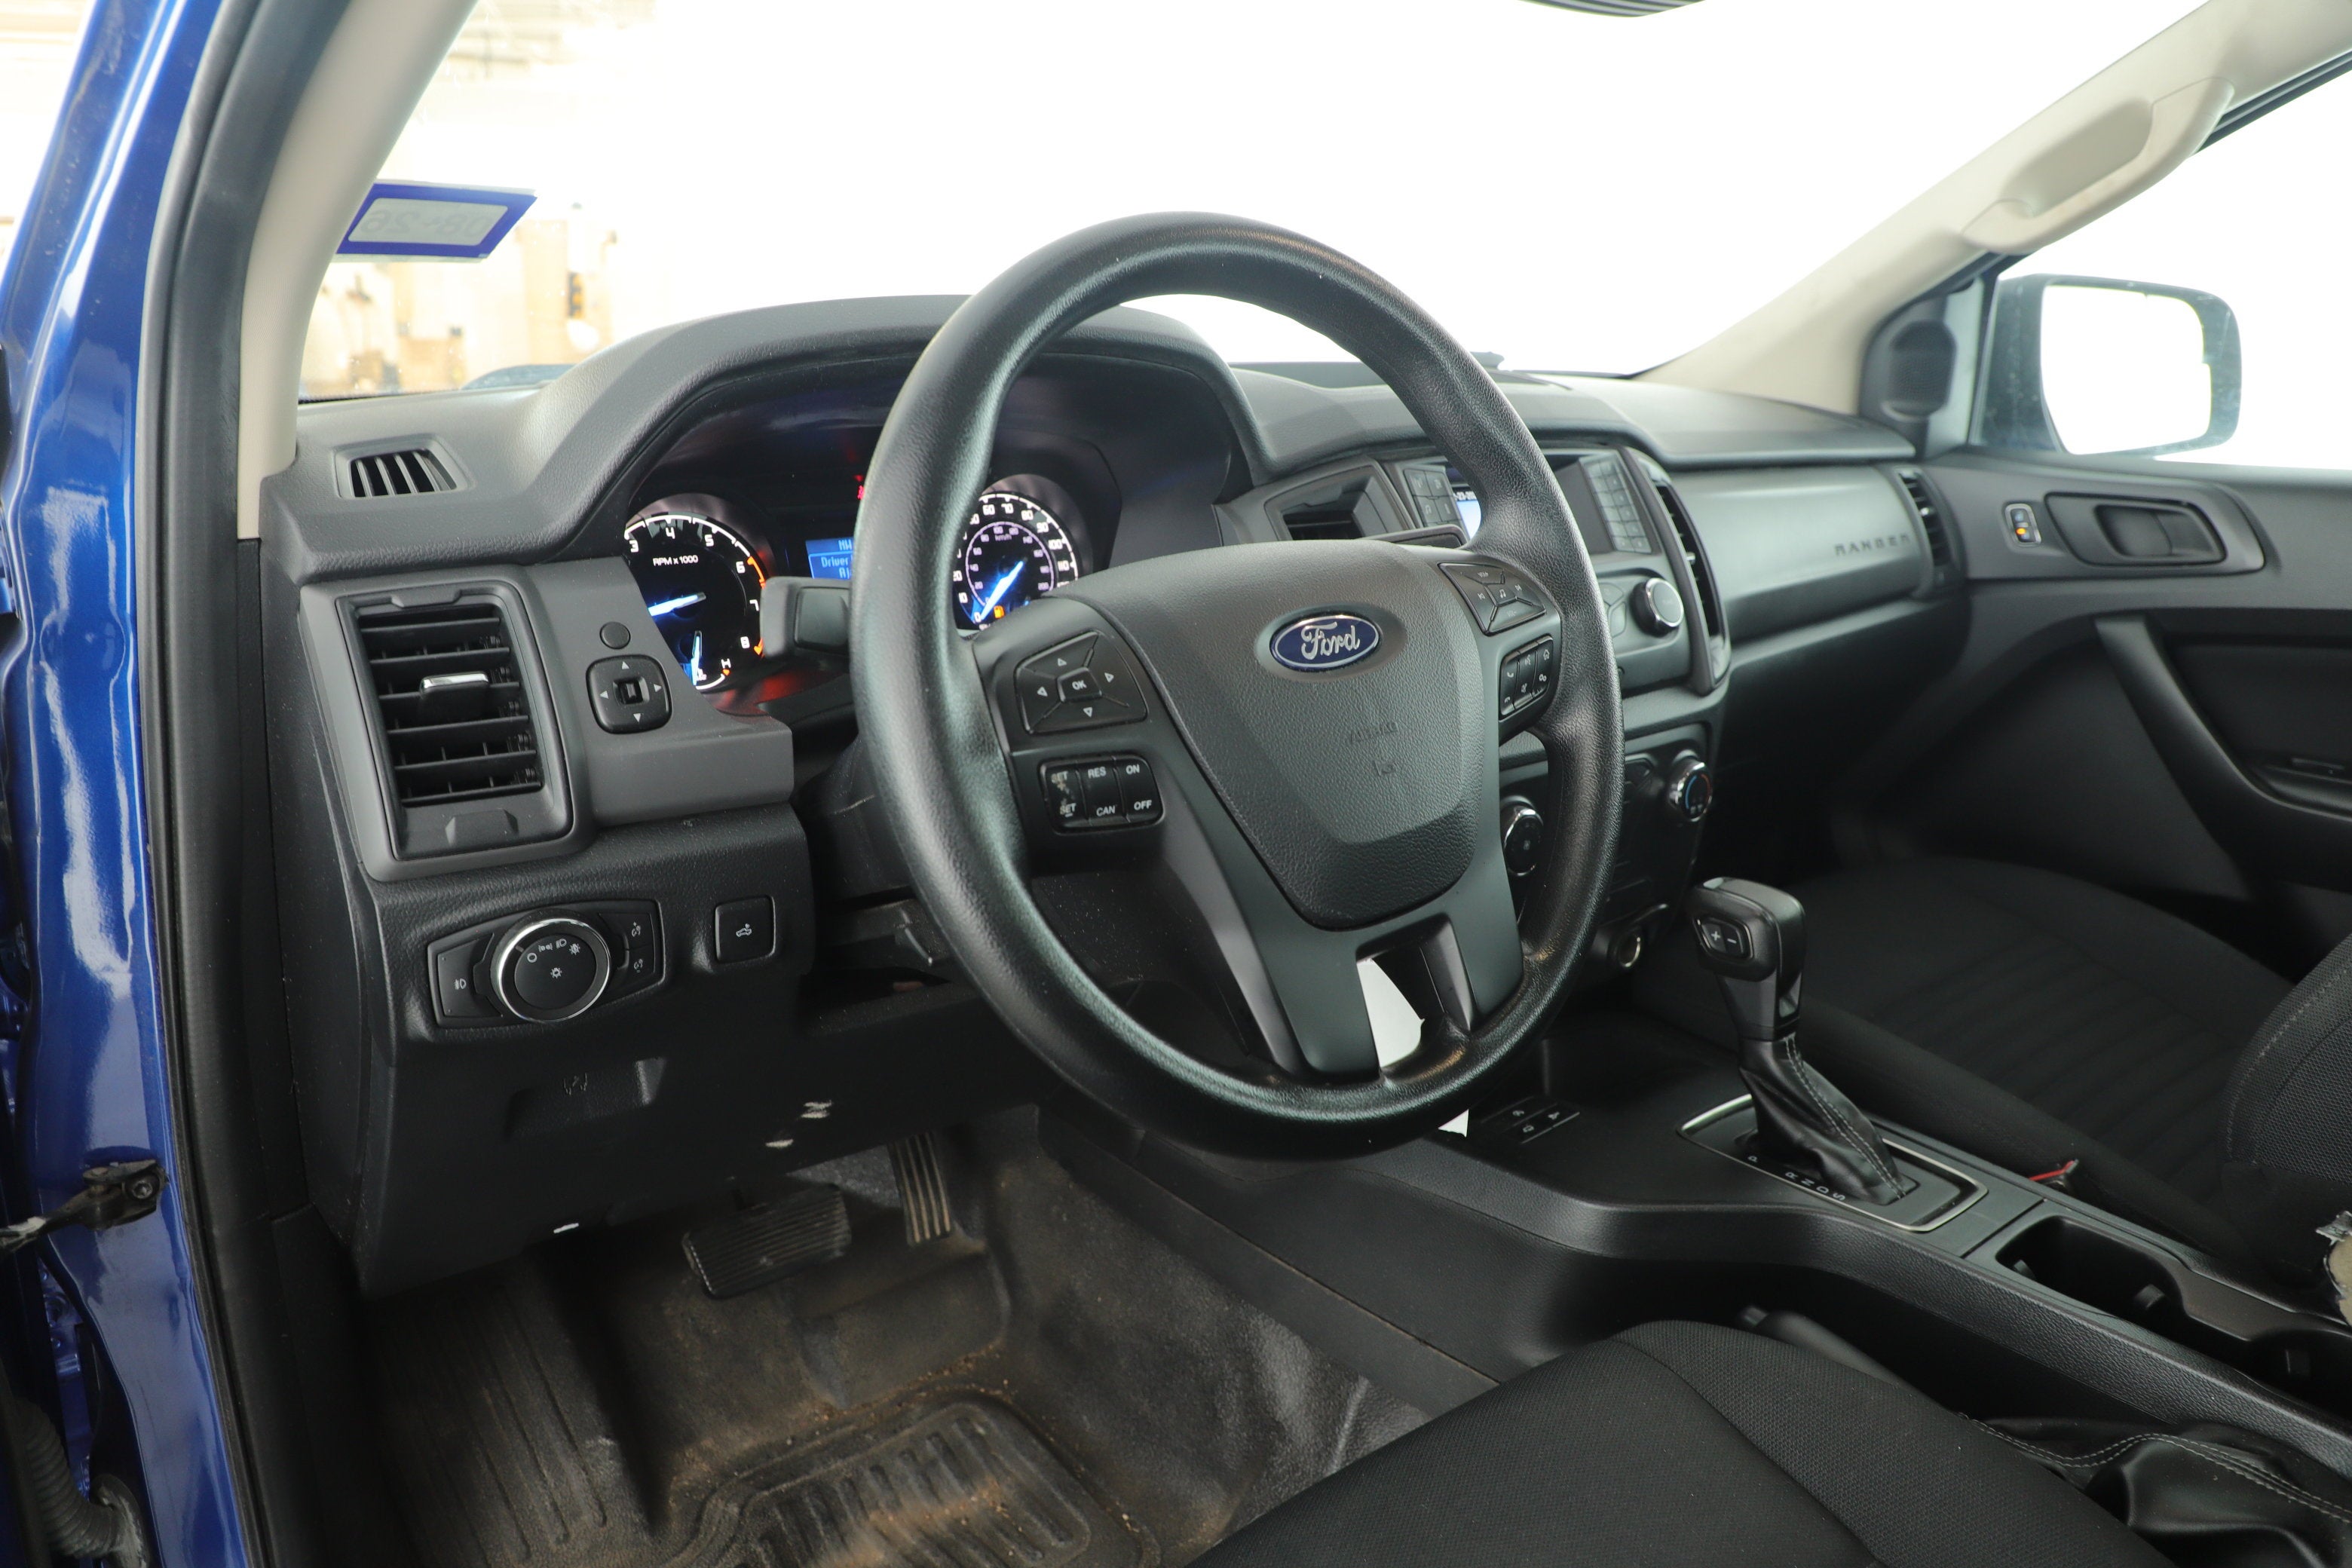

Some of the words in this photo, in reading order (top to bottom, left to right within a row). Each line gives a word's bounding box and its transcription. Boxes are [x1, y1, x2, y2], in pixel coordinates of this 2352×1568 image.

[982, 504, 995, 516] 60
[1001, 503, 1014, 514] 70
[1021, 510, 1034, 521] 80
[666, 527, 675, 539] 4
[1037, 522, 1049, 533] 90
[704, 534, 715, 547] 5
[1048, 539, 1064, 550] 100
[629, 540, 639, 553] 3
[653, 557, 672, 566] RPM
[679, 555, 699, 564] 1000
[821, 556, 849, 568] Driver
[736, 561, 746, 573] 6
[749, 599, 759, 611] 7
[740, 636, 750, 648] 8
[1300, 621, 1361, 660] Ford
[721, 658, 731, 668] H
[1072, 680, 1086, 691] OK
[1088, 766, 1106, 779] RES
[1125, 764, 1140, 775] ON
[1052, 771, 1068, 784] SET
[1060, 803, 1076, 814] SET
[1096, 804, 1116, 816] CAN
[1134, 800, 1152, 811] OFF
[1785, 1171, 1799, 1180] R
[1816, 1186, 1829, 1194] D
[1833, 1193, 1845, 1201] S
